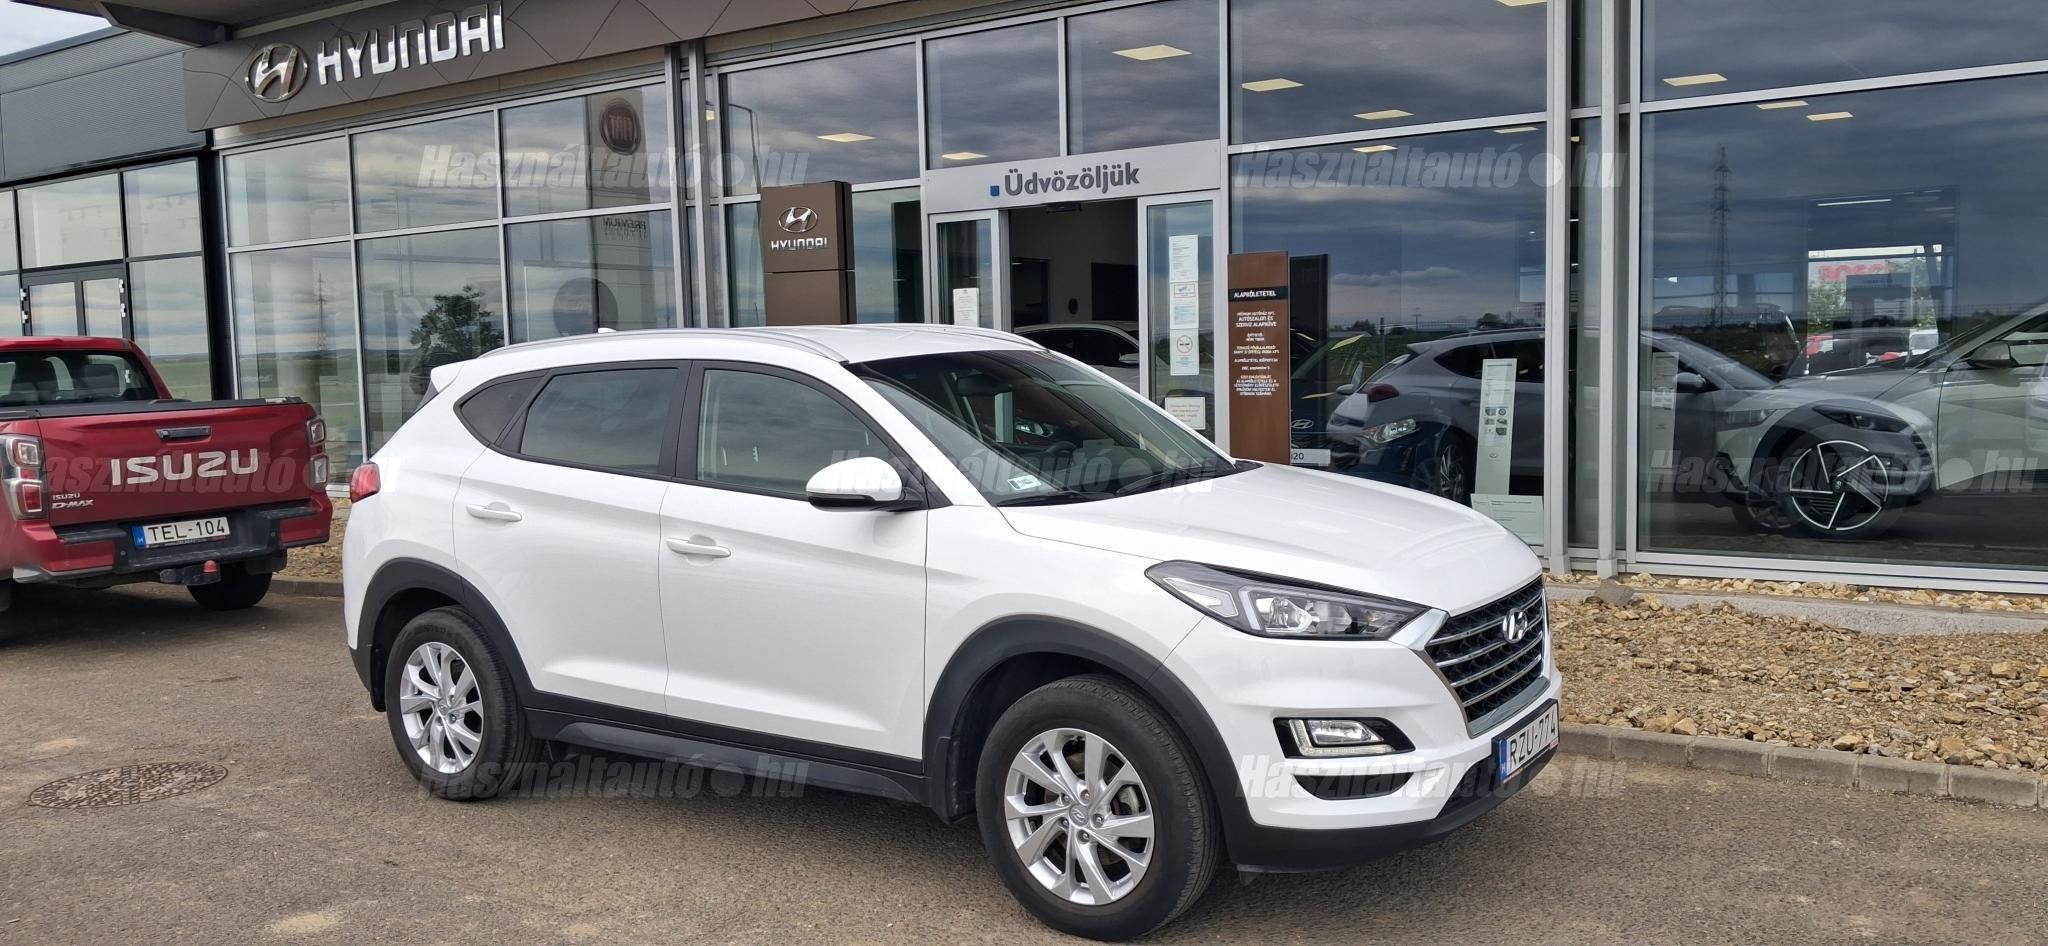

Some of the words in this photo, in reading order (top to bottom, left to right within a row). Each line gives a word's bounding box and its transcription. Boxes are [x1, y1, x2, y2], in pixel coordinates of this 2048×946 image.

[317, 2, 504, 86] HYUNDAI
[1004, 162, 1140, 196] Üdvözöljük
[770, 237, 828, 251] HYUNDAI
[110, 448, 259, 486] ISUZU
[52, 492, 80, 501] ISUZU
[52, 499, 94, 509] D-MAX
[148, 519, 225, 542] TEL-104
[1509, 710, 1556, 769] RZU-774
